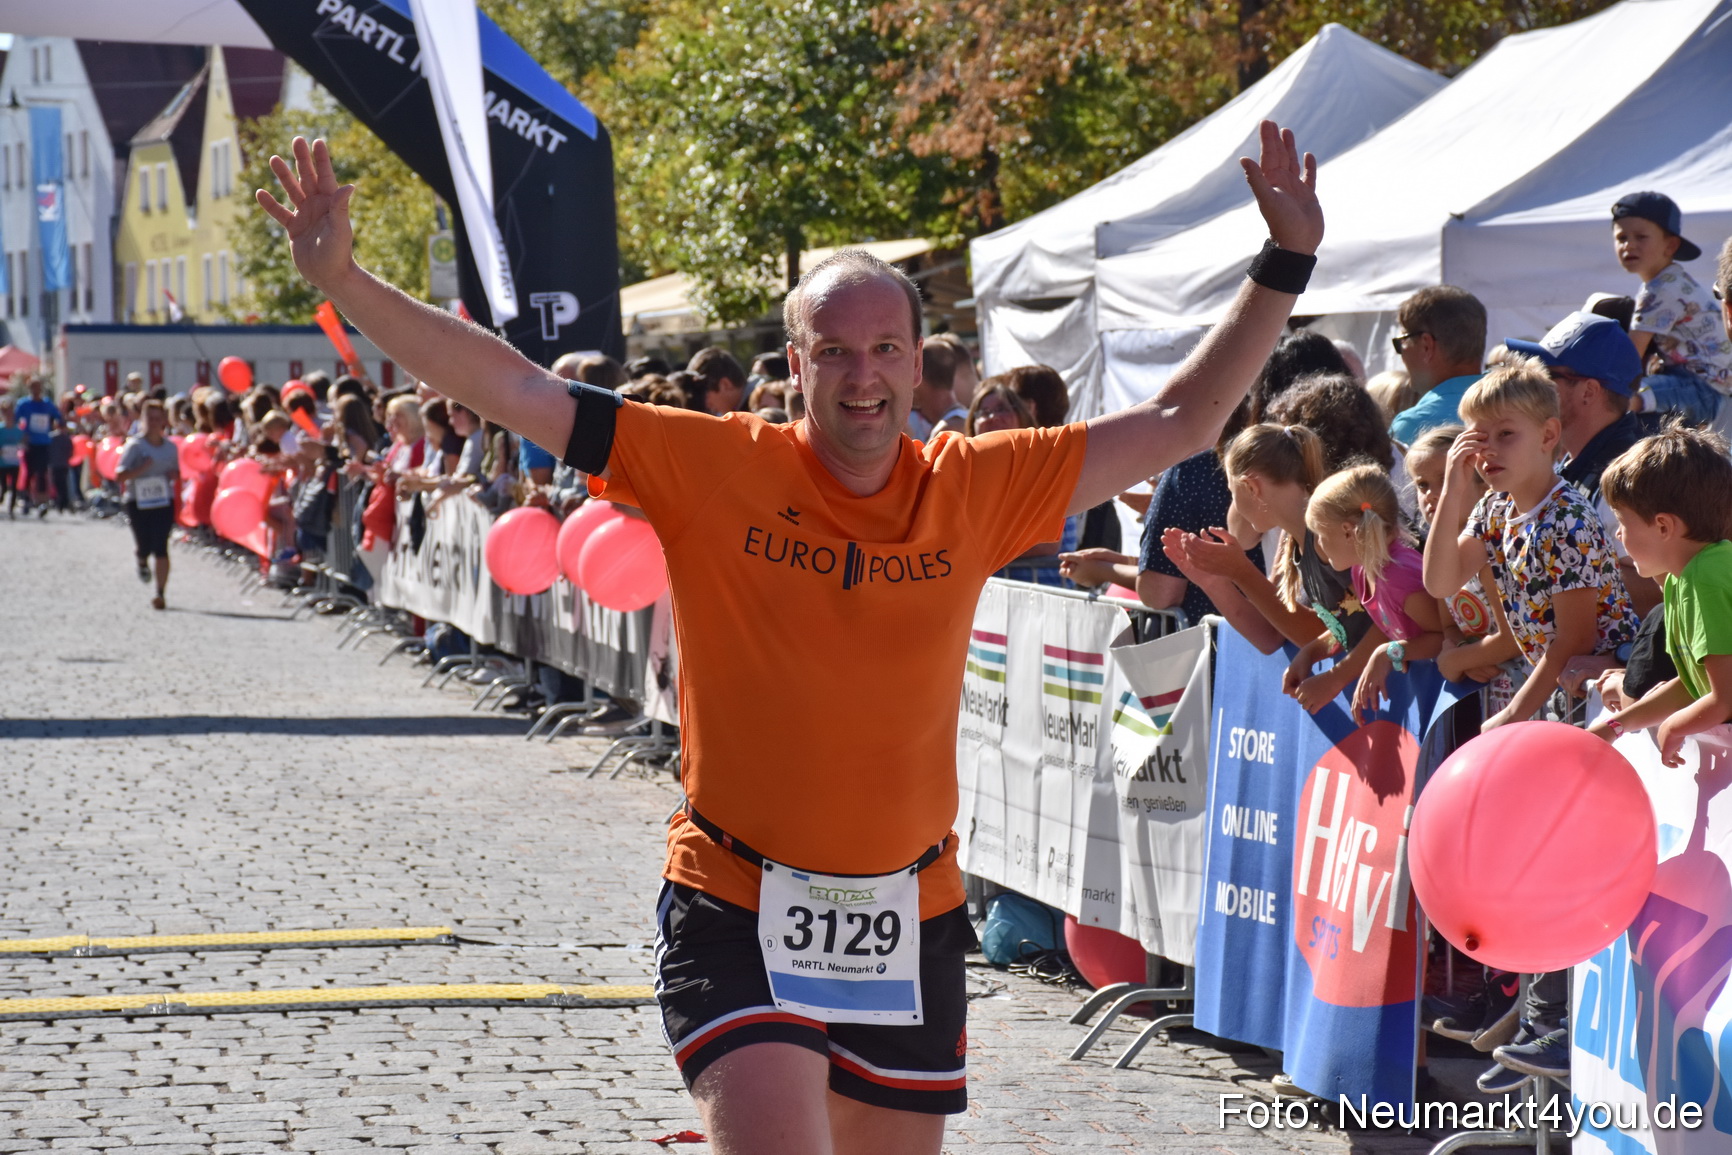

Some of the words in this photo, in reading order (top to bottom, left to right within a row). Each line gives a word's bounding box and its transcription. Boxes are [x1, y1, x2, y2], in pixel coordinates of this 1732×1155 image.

[316, 0, 406, 65] PARTL
[777, 511, 800, 526] erima
[744, 526, 837, 575] EURO
[869, 549, 952, 583] POLES
[1228, 726, 1276, 765] STORE
[1221, 803, 1279, 845] ONLINE
[1215, 881, 1277, 925] MOBILE
[783, 905, 901, 957] 3129
[792, 959, 825, 971] PARTL
[827, 962, 874, 974] Neumarkt
